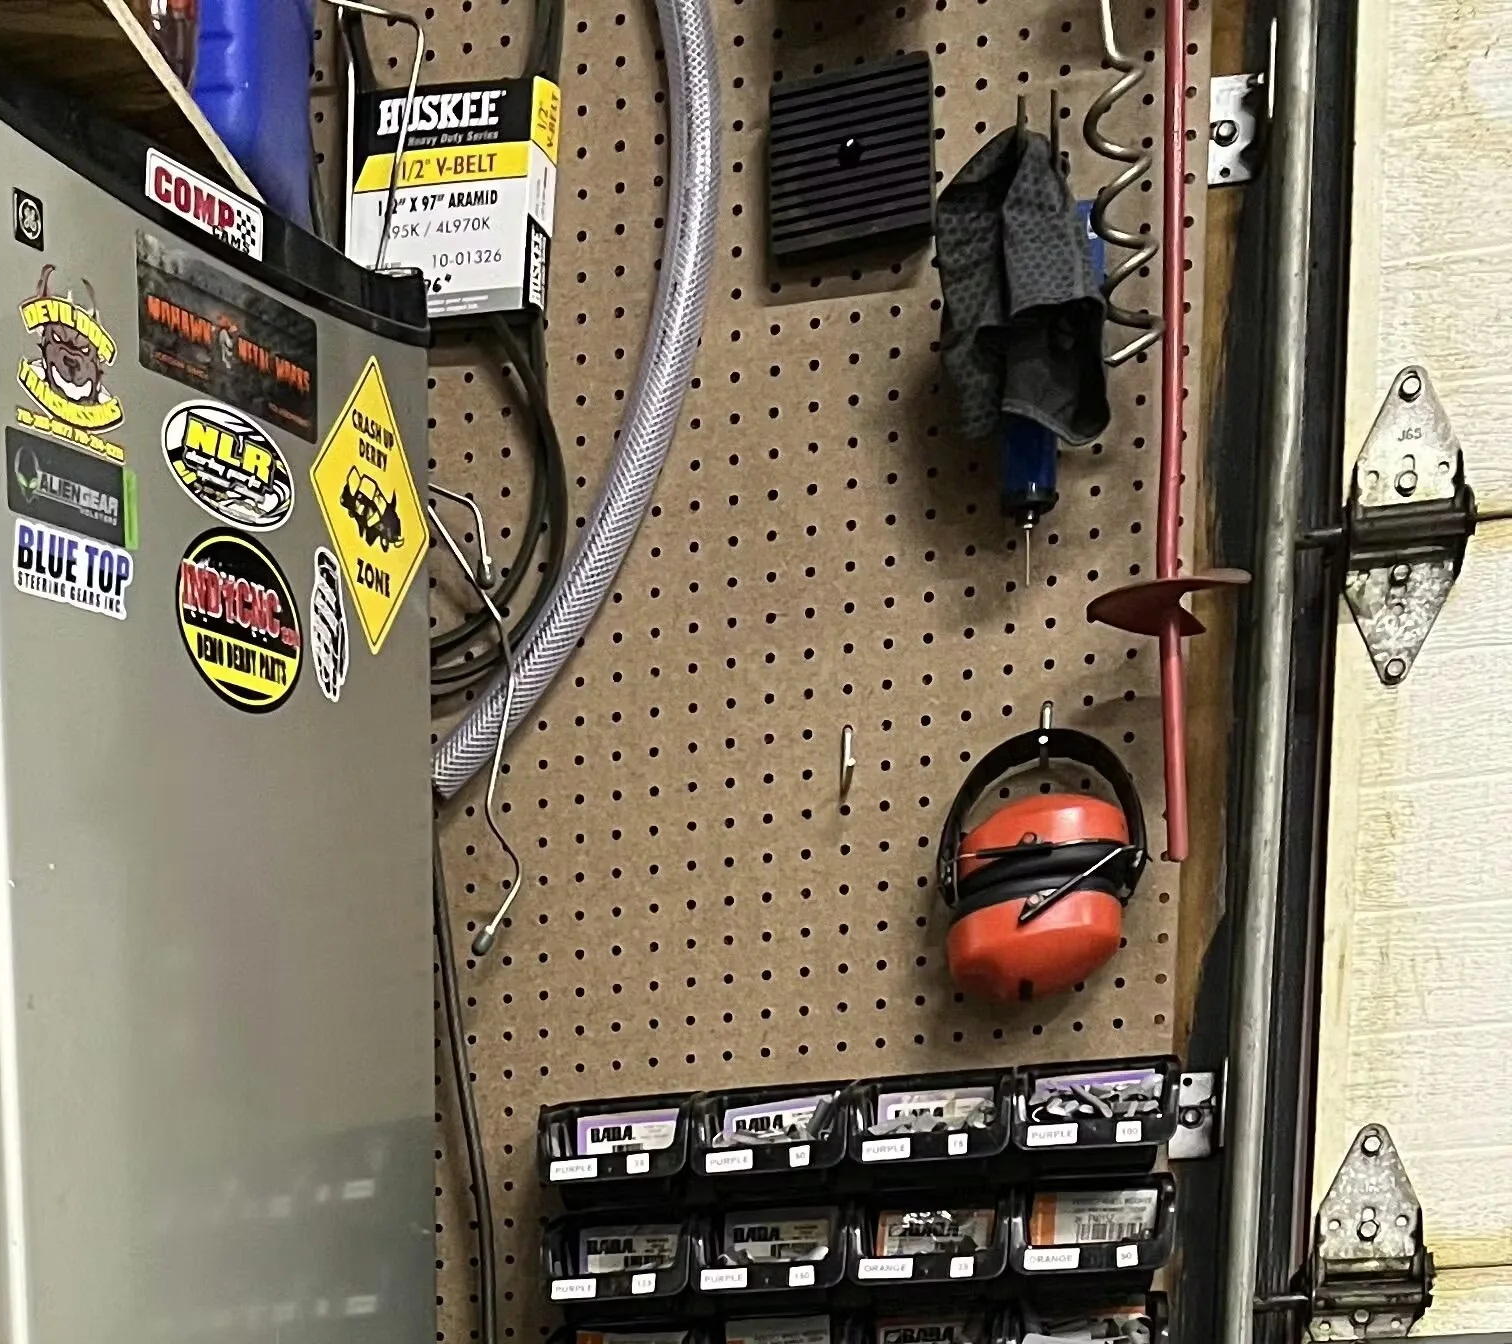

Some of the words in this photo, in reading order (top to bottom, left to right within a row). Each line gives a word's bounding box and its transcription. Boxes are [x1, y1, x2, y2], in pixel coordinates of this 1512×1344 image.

[377, 90, 499, 135] HUSKEE
[436, 153, 498, 176] V-BELT
[154, 166, 235, 231] COMP
[448, 190, 499, 208] ARAMID
[386, 223, 420, 240] 95K
[436, 216, 492, 235] 4L970K
[431, 250, 503, 268] 10-01326
[352, 408, 382, 444] CRASH
[383, 428, 395, 450] UP
[185, 417, 272, 484] NLR
[359, 437, 389, 473] DERBY
[18, 524, 79, 583] BLUE
[85, 545, 131, 597] TOP
[356, 557, 391, 599] ZONE
[17, 571, 66, 598] STEERING
[69, 586, 101, 608] GEARS
[1031, 1130, 1073, 1140] PURPLE
